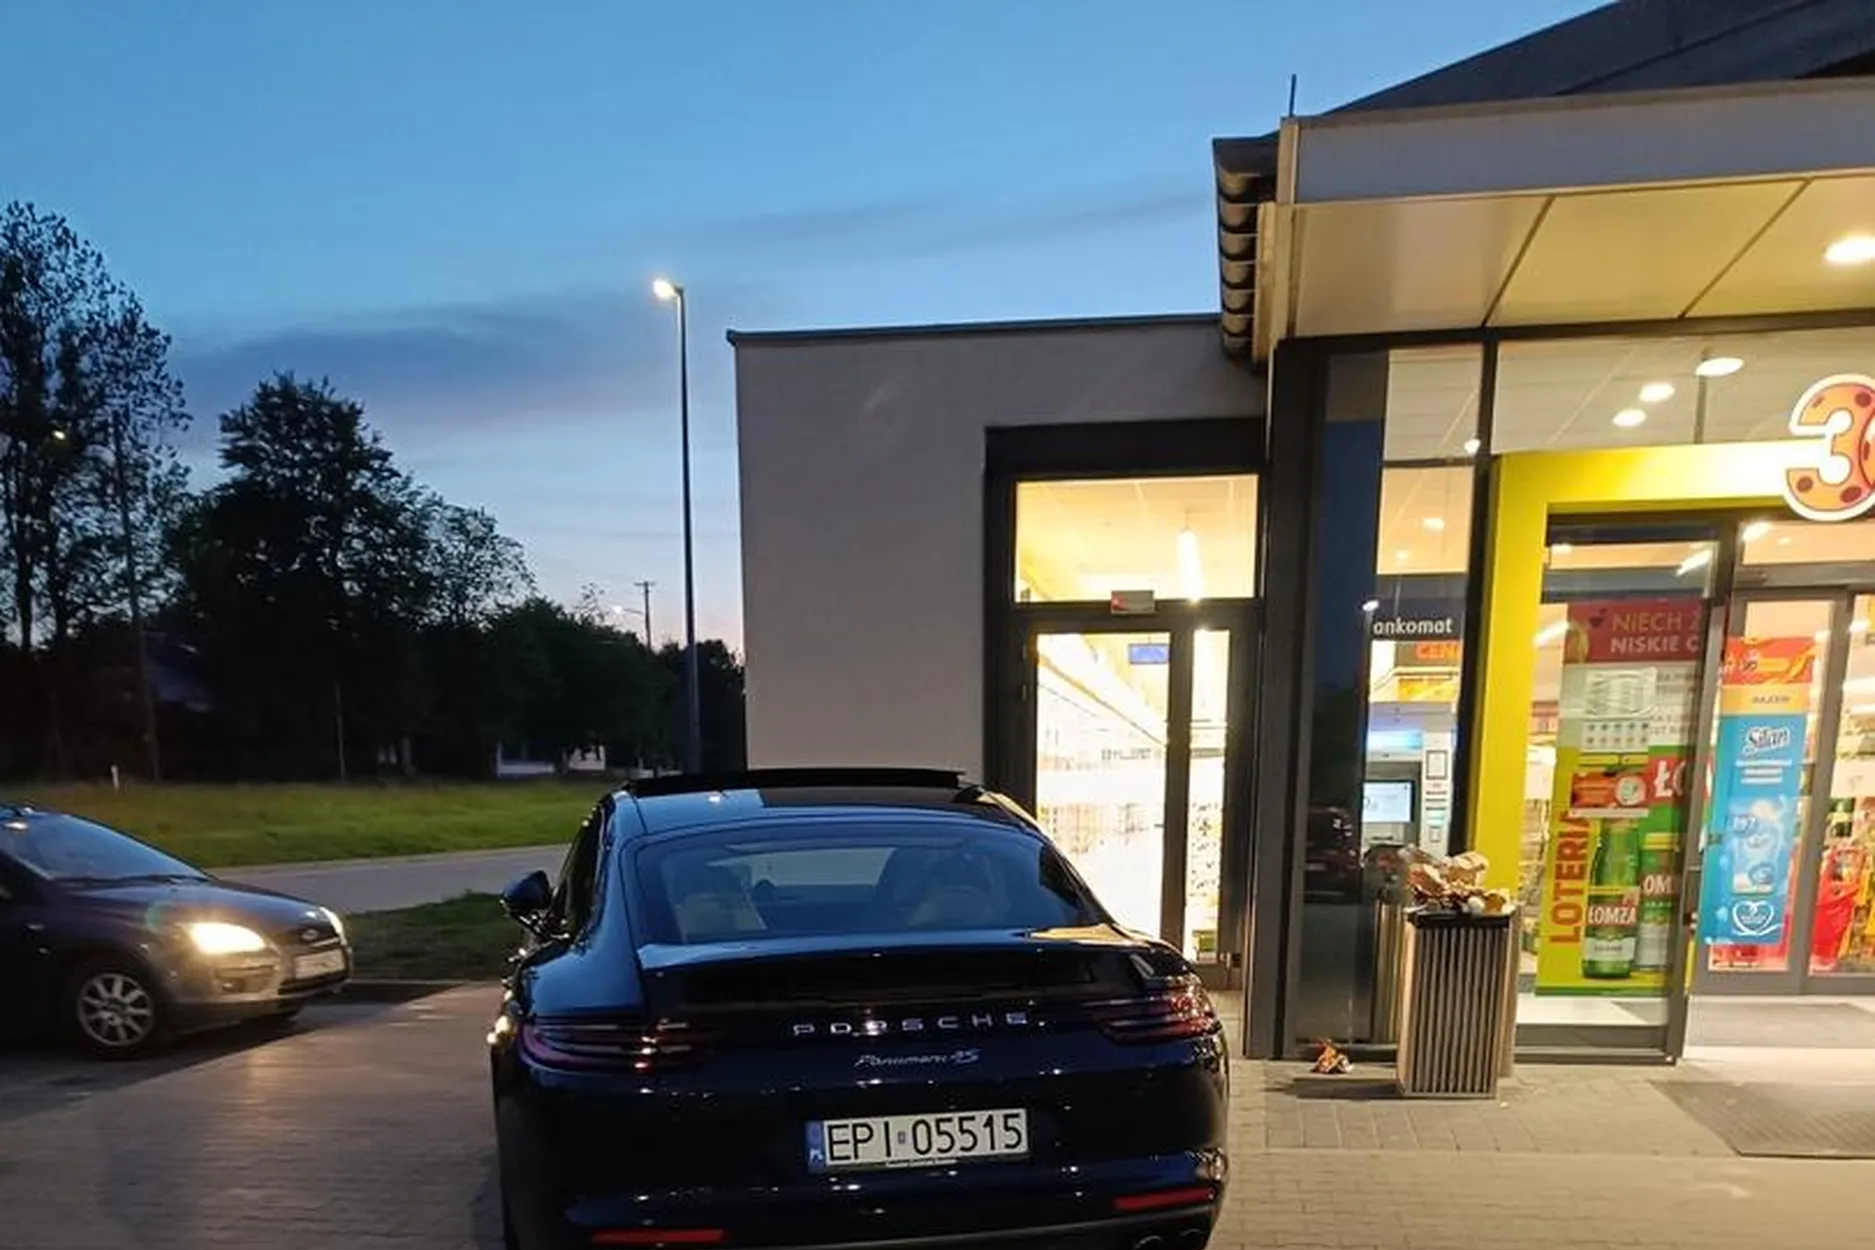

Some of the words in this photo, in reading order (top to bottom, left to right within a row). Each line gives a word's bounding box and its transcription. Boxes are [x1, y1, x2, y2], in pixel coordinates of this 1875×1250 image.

[1785, 374, 1875, 521] 3
[1372, 616, 1453, 635] ankomat
[1612, 611, 1682, 632] NIECH
[1609, 635, 1679, 654] NISKIE
[792, 1011, 1028, 1036] PORSCHE
[827, 1120, 892, 1161] EPI
[911, 1113, 1023, 1156] 05515
